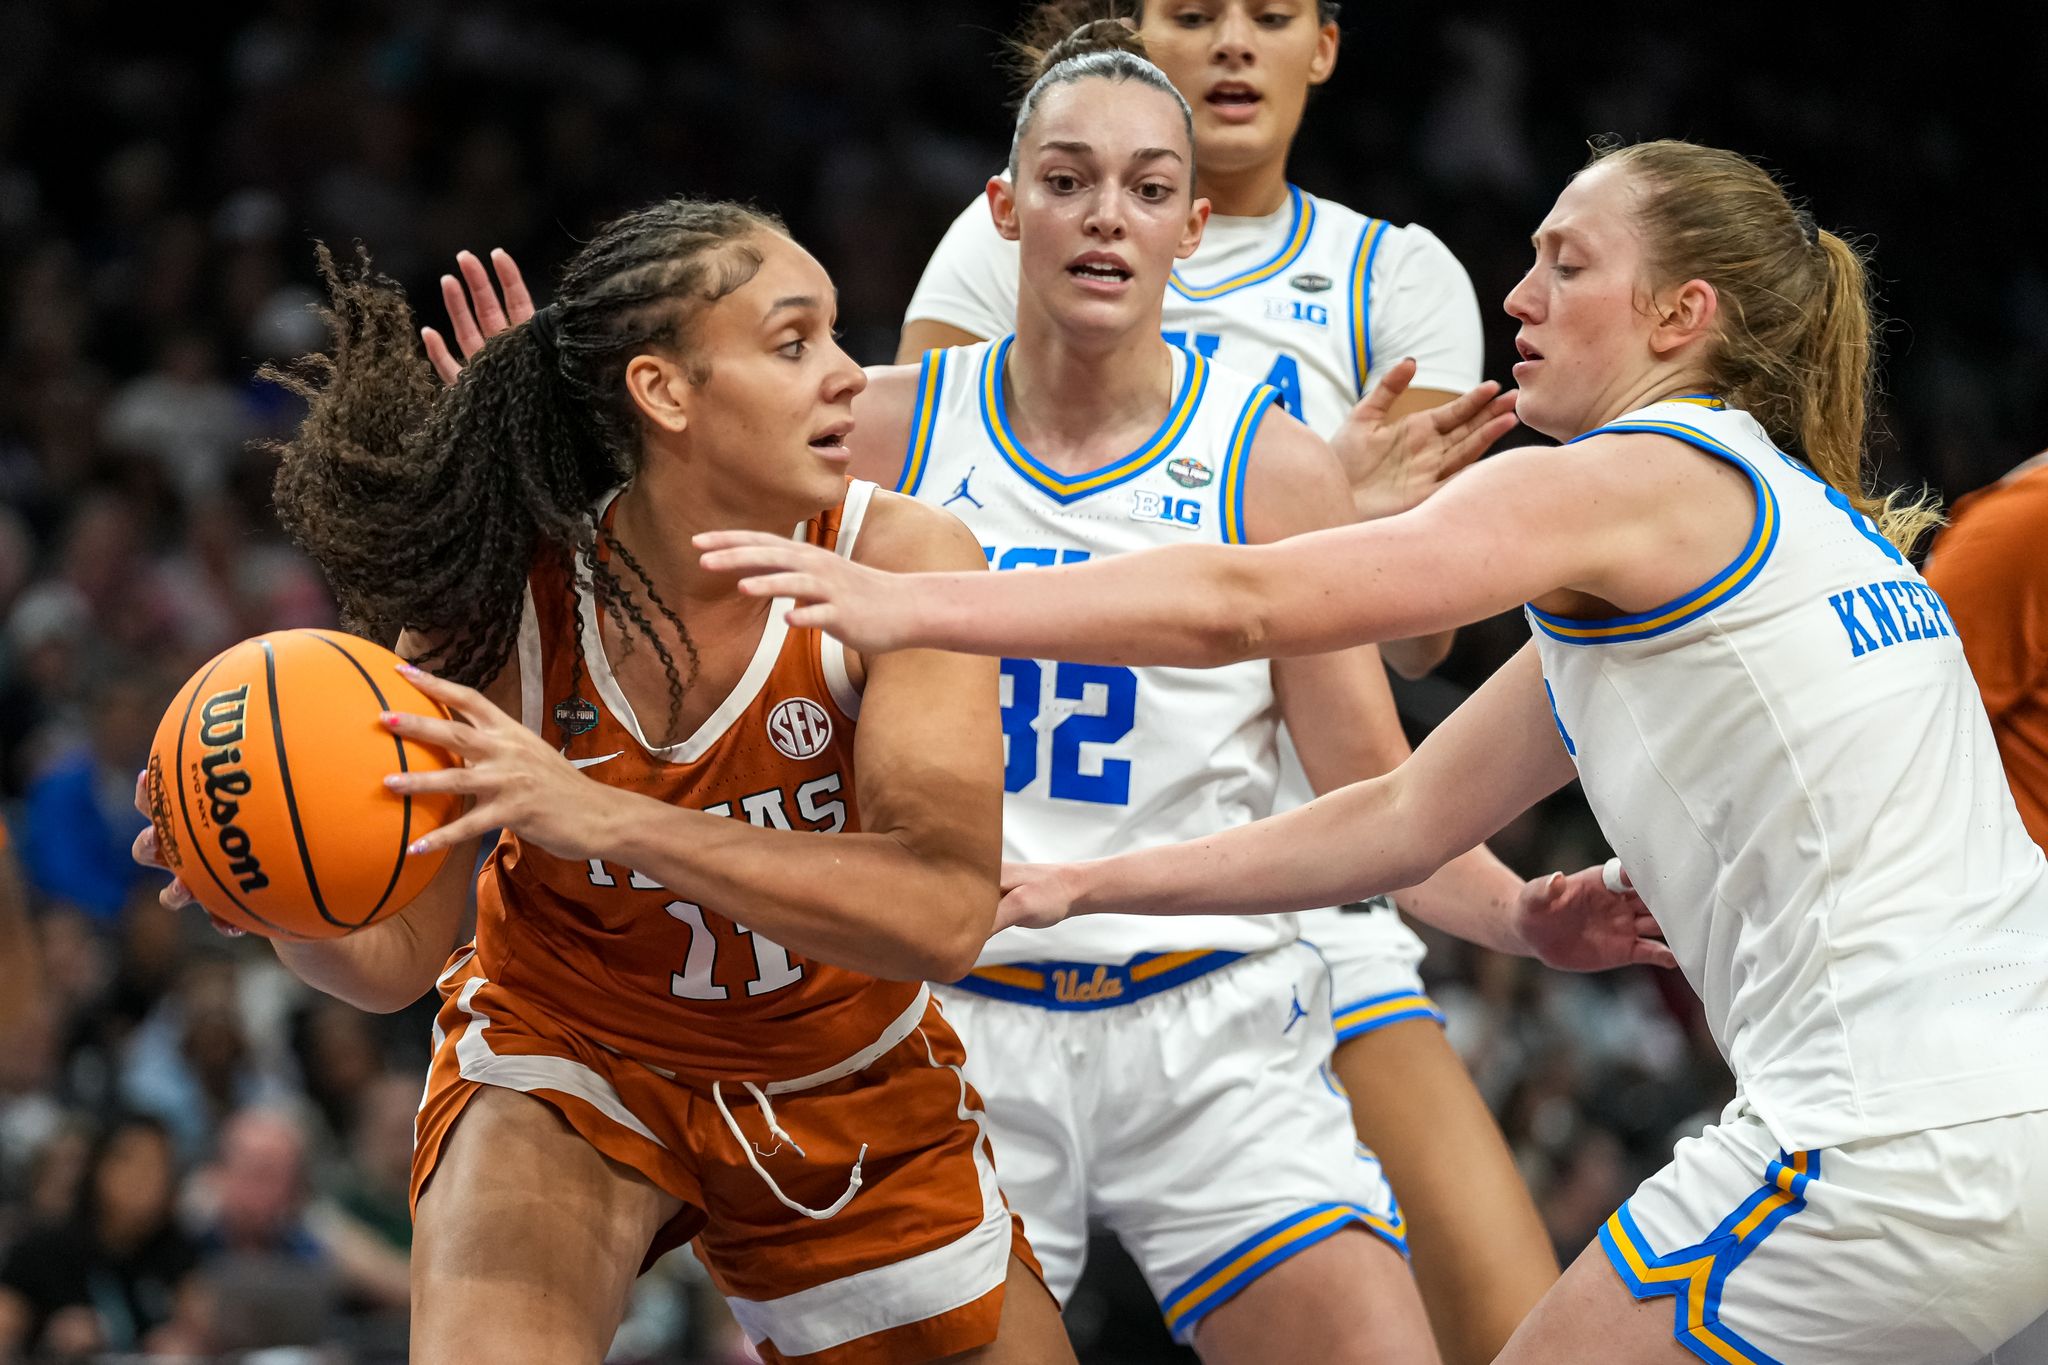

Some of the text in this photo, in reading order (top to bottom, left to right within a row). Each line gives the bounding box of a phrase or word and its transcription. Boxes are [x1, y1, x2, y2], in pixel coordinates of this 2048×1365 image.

[1828, 581, 1960, 658] KNEEP
[576, 710, 595, 720] FOUR
[771, 701, 828, 756] SEC
[191, 762, 202, 795] EVO
[199, 683, 270, 894] Wilson
[664, 900, 803, 1000] 11
